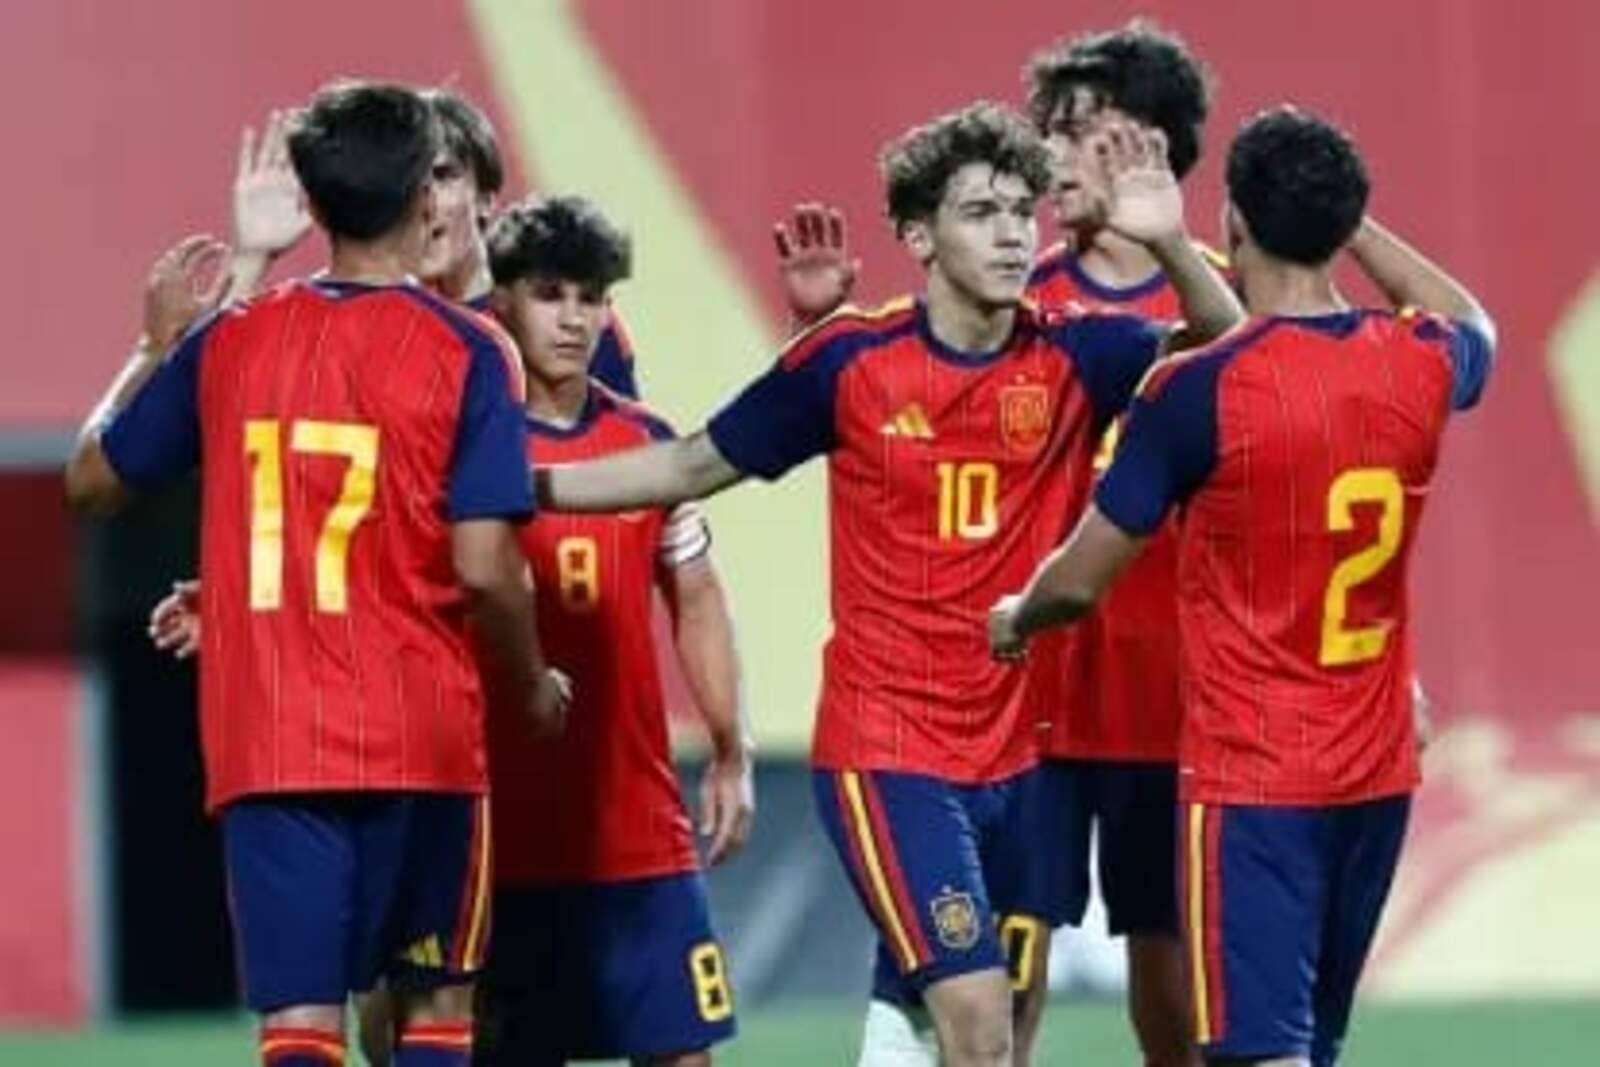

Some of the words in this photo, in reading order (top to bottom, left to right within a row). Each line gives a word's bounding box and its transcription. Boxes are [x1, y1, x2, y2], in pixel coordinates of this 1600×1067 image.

[244, 420, 380, 613] 17
[936, 463, 999, 540] 10
[557, 536, 599, 608] 8
[1318, 469, 1404, 666] 2
[691, 944, 733, 1021] 8
